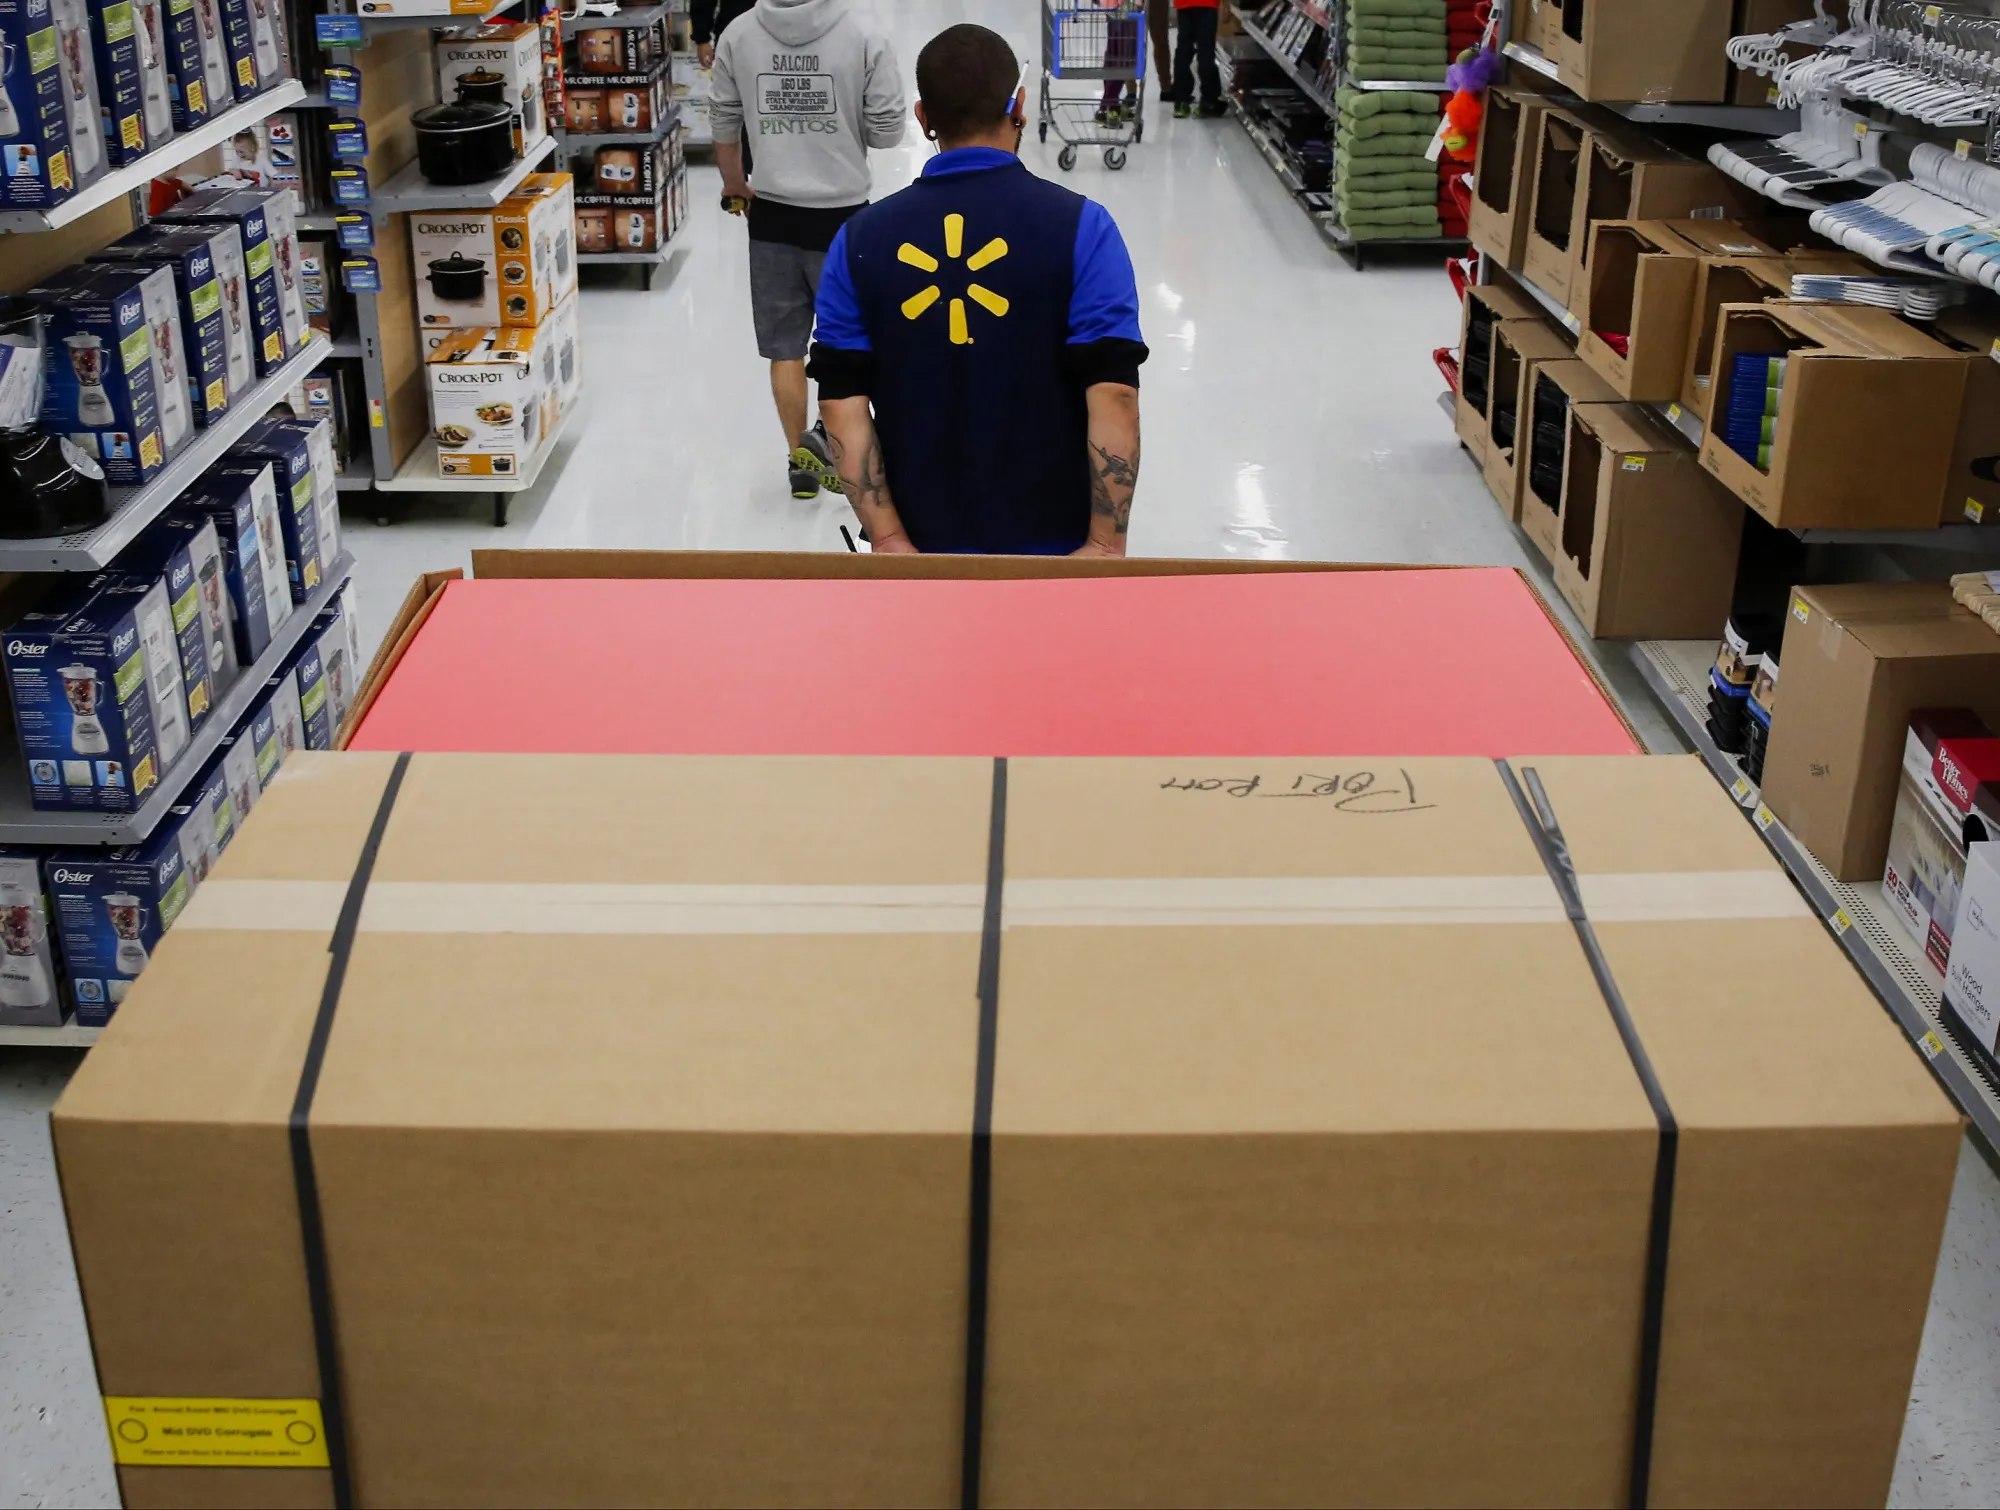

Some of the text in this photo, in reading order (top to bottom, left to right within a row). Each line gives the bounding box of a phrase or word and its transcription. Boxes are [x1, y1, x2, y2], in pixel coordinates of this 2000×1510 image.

[772, 54, 819, 71] SALCIDO
[797, 78, 811, 90] LBS
[759, 119, 838, 135] PINTOS
[7, 639, 49, 656] Oster
[113, 628, 135, 657] Oster
[1938, 746, 1961, 778] Better
[1942, 768, 1968, 799] Homes
[53, 868, 94, 884] Oster
[1887, 866, 1898, 887] 30
[1962, 964, 1983, 995] Wood
[1962, 980, 1992, 1022] Hangers
[186, 1427, 212, 1436] DVD
[215, 1427, 273, 1438] Corrugate
